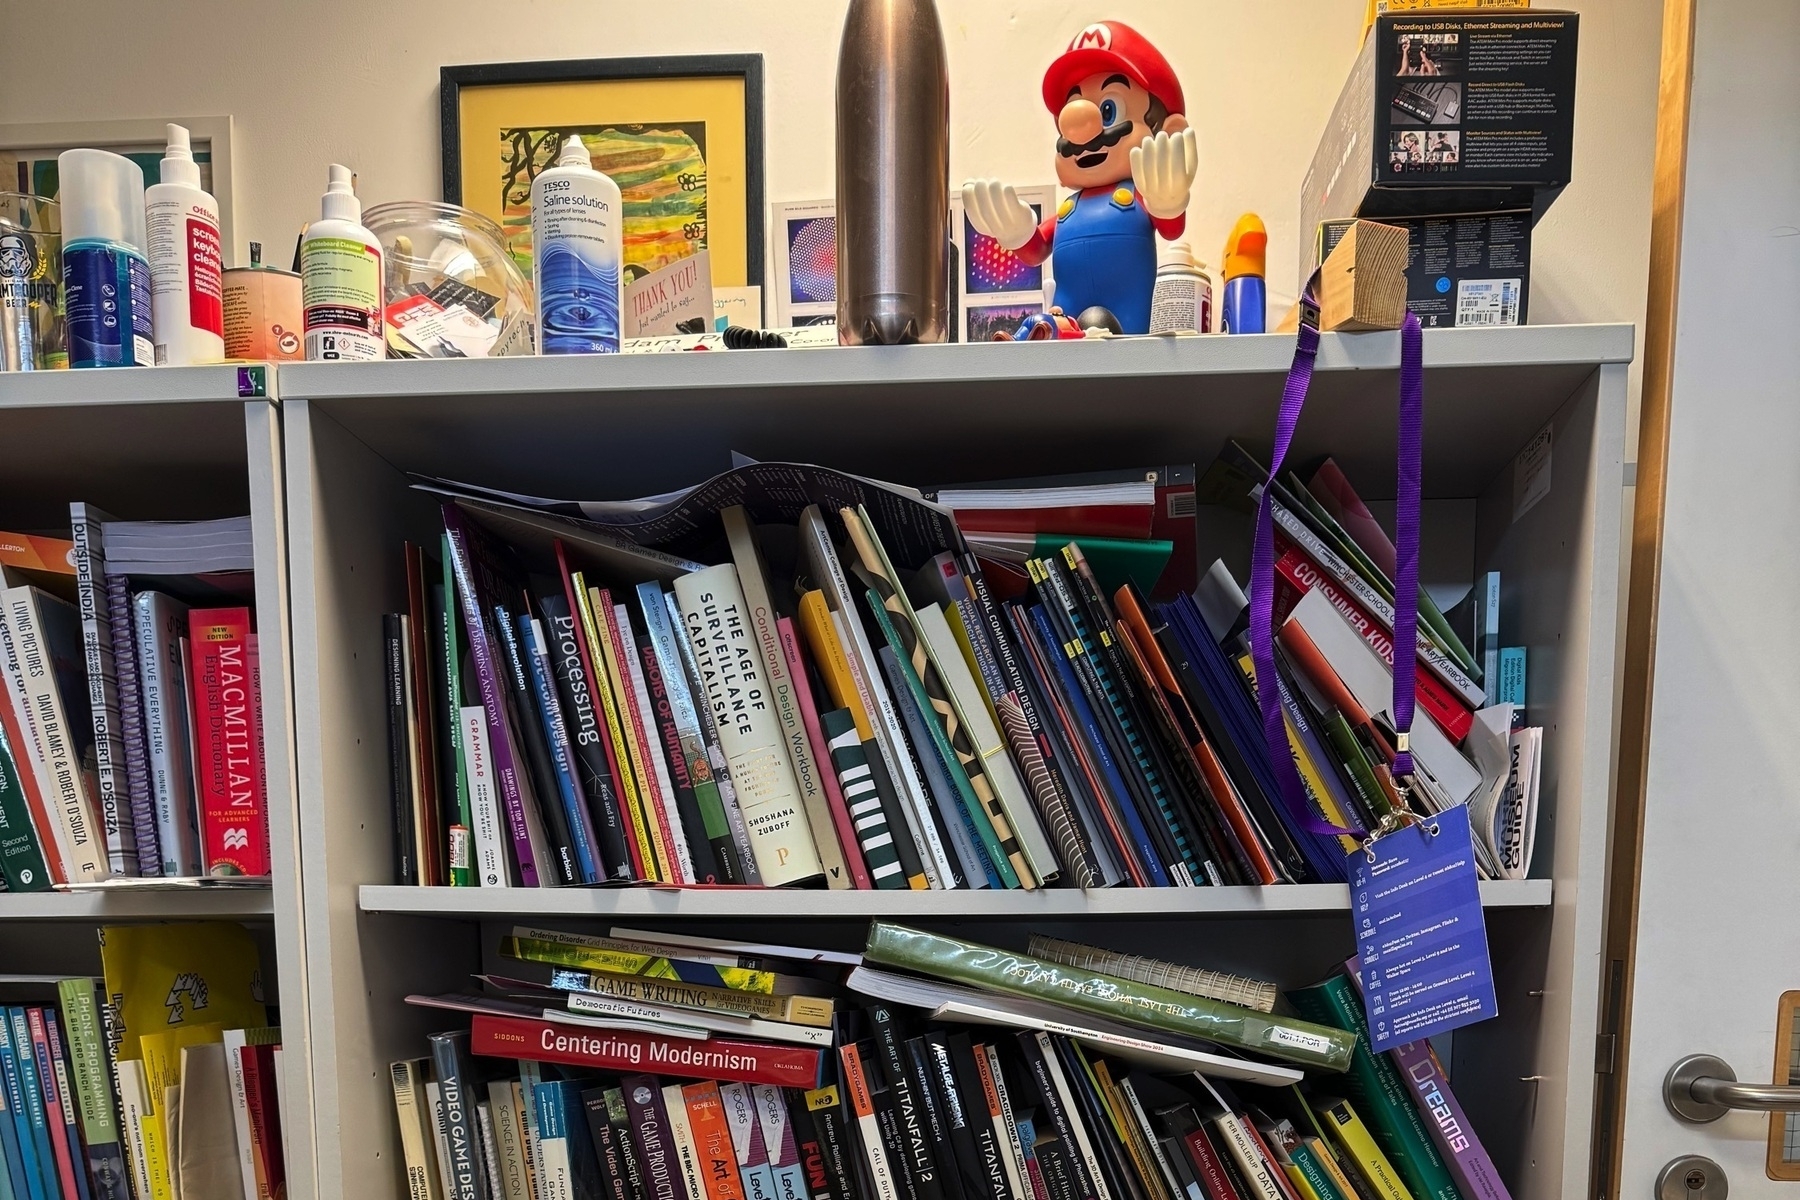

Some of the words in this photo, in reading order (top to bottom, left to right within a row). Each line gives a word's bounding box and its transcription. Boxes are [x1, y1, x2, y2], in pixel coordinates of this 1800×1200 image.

[1393, 23, 1423, 31] Recording
[1445, 22, 1462, 31] Disks,
[1490, 21, 1519, 30] Streaming
[544, 181, 570, 189] TESCO
[544, 195, 571, 208] Saline
[572, 197, 609, 212] solution
[632, 280, 667, 318] THANK
[671, 260, 698, 297] YOU!
[591, 343, 604, 352] 360
[74, 524, 89, 582] OUTSIDE
[12, 601, 32, 631] LIVING
[79, 586, 95, 622] INDIA
[1293, 563, 1369, 633] CONSUMER
[1366, 627, 1395, 666] KIDS
[21, 633, 44, 677] PICTURES
[688, 612, 730, 727] CAPITALISM
[700, 593, 752, 735] SURVEILLANCE
[724, 605, 744, 640] THE
[736, 647, 757, 682] AGE
[749, 693, 765, 711] OF
[975, 579, 990, 613] VISUAL
[990, 615, 1026, 694] COMMUNICATION
[1021, 695, 1040, 731] DESIGN
[141, 607, 156, 681] SPECULATIVE
[149, 686, 163, 754] EVERYTHING
[203, 655, 219, 712] English
[555, 615, 599, 746] Processing
[37, 694, 55, 721] DAVID
[755, 607, 785, 681] Conditional
[777, 684, 795, 729] Design
[792, 732, 818, 797] Workbook
[45, 722, 65, 759] BLAMEY
[219, 645, 252, 808] MACMILLAN
[210, 716, 225, 796] Dictionary
[469, 718, 485, 779] GRAMMAR
[57, 770, 78, 809] ROBERT
[1503, 744, 1521, 870] MUSEUM
[67, 808, 87, 846] D'SOUZA
[749, 808, 795, 828] SHOSHANA
[758, 821, 790, 836] ZUBOFF
[1510, 781, 1525, 869] GUIDE
[2, 834, 28, 848] Second
[5, 844, 31, 857] Edition
[1360, 927, 1377, 940] SCHEDULE
[1364, 953, 1379, 965] CONNECT
[67, 997, 76, 1014] THE
[575, 998, 624, 1013] Democratic
[626, 1005, 662, 1019] Futures
[594, 975, 637, 998] GAME
[641, 983, 708, 1007] WRITING
[70, 1019, 79, 1032] BIG
[494, 1032, 526, 1043] SIDDONS
[74, 1036, 83, 1059] NERD
[541, 1028, 642, 1064] Centering
[649, 1042, 758, 1072] Modernism
[78, 1063, 89, 1090] RANCH
[87, 1043, 109, 1127] PROGRAMMING
[848, 1052, 867, 1110] BRADYGAMES
[84, 1095, 94, 1120] GUIDE
[443, 1076, 462, 1123] VIDEO
[692, 1101, 718, 1111] SCHELL
[731, 1088, 747, 1125] ROGERS
[1408, 1058, 1471, 1155] Dreams
[704, 1129, 720, 1156] The
[895, 1077, 928, 1168] TITANFALL
[921, 1173, 933, 1183] 2
[451, 1127, 470, 1171] GAME
[802, 1141, 827, 1189] FUN
[711, 1159, 727, 1181] Art
[1257, 1171, 1276, 1199] DATA
[718, 1183, 732, 1196] of
